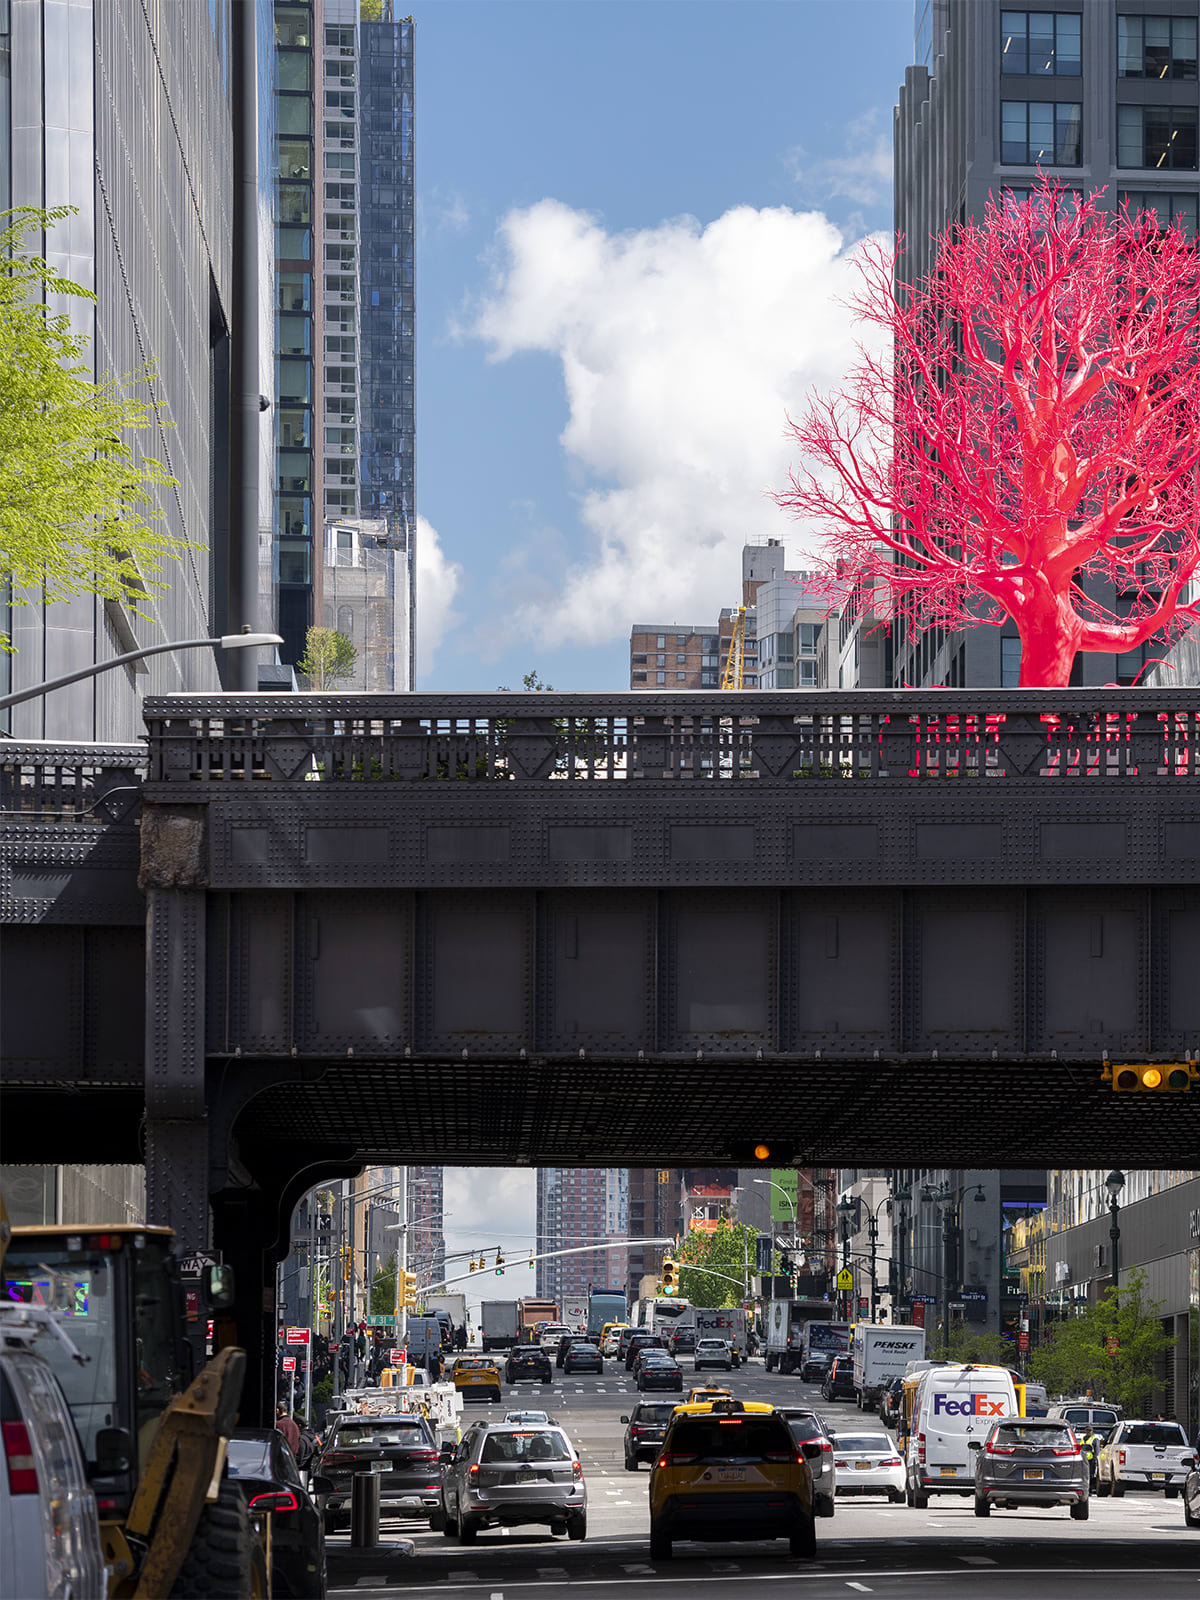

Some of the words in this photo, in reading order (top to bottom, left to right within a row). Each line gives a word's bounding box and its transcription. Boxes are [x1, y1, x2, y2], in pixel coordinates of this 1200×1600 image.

[697, 1317, 734, 1329] FedEx
[873, 1341, 917, 1349] PENSKE
[934, 1394, 1005, 1416] FedEx
